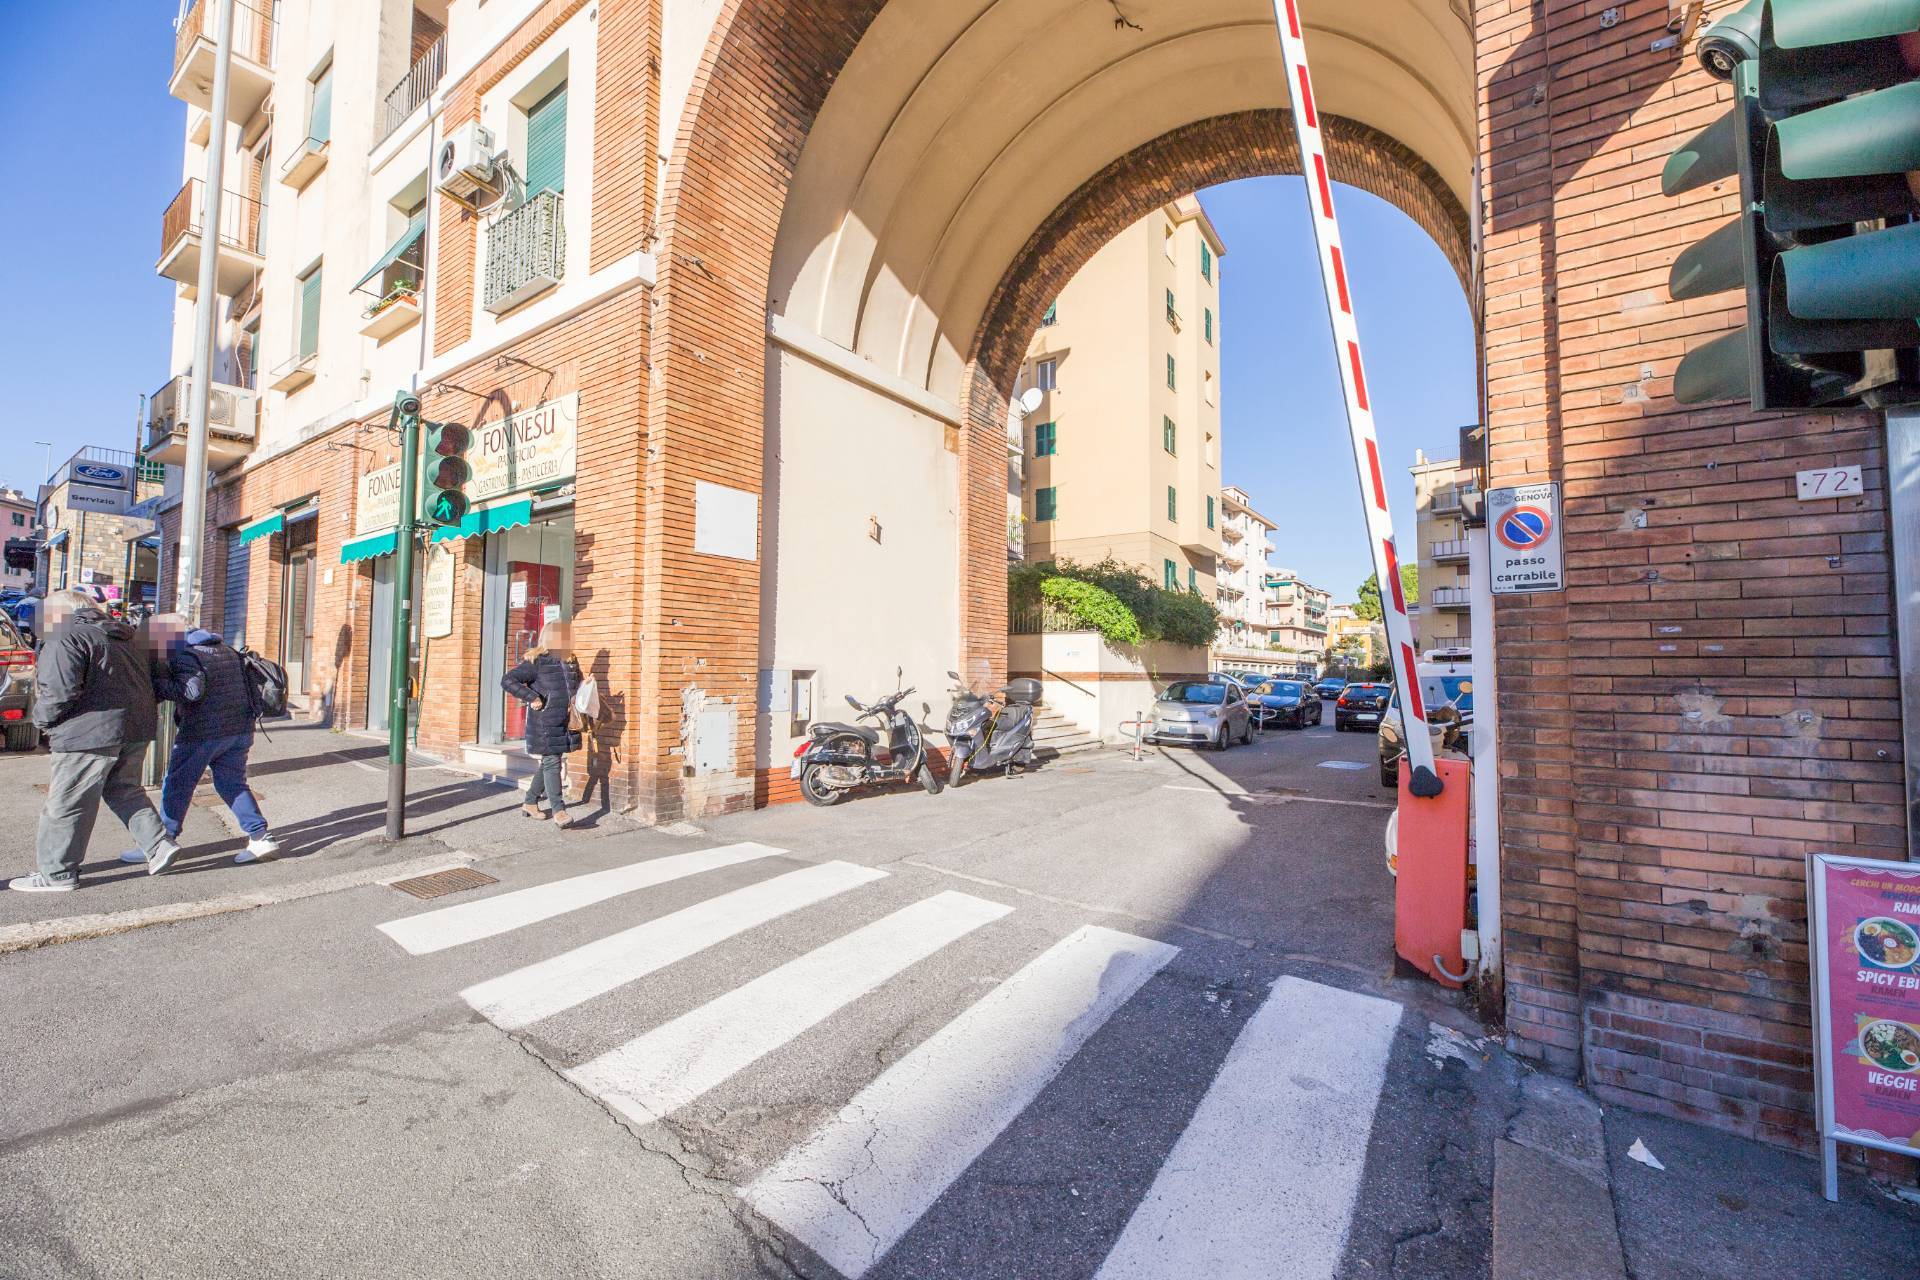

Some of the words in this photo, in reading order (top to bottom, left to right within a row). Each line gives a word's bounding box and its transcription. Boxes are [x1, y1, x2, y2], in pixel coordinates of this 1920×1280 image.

[483, 408, 555, 456] FONNESU
[497, 445, 536, 469] PANIFICIO
[368, 468, 401, 498] FONNE
[478, 471, 518, 494] GASTRONOMIA
[521, 459, 558, 481] PASTICCERIA
[1812, 471, 1849, 495] 72
[71, 494, 115, 505] Servizio
[1514, 492, 1553, 502] GENOVA
[1505, 557, 1546, 568] passo
[1496, 570, 1557, 582] carrabile
[1856, 970, 1896, 986] SPICY
[1898, 975, 1920, 990] EBI
[1868, 1071, 1918, 1092] VEGGIE
